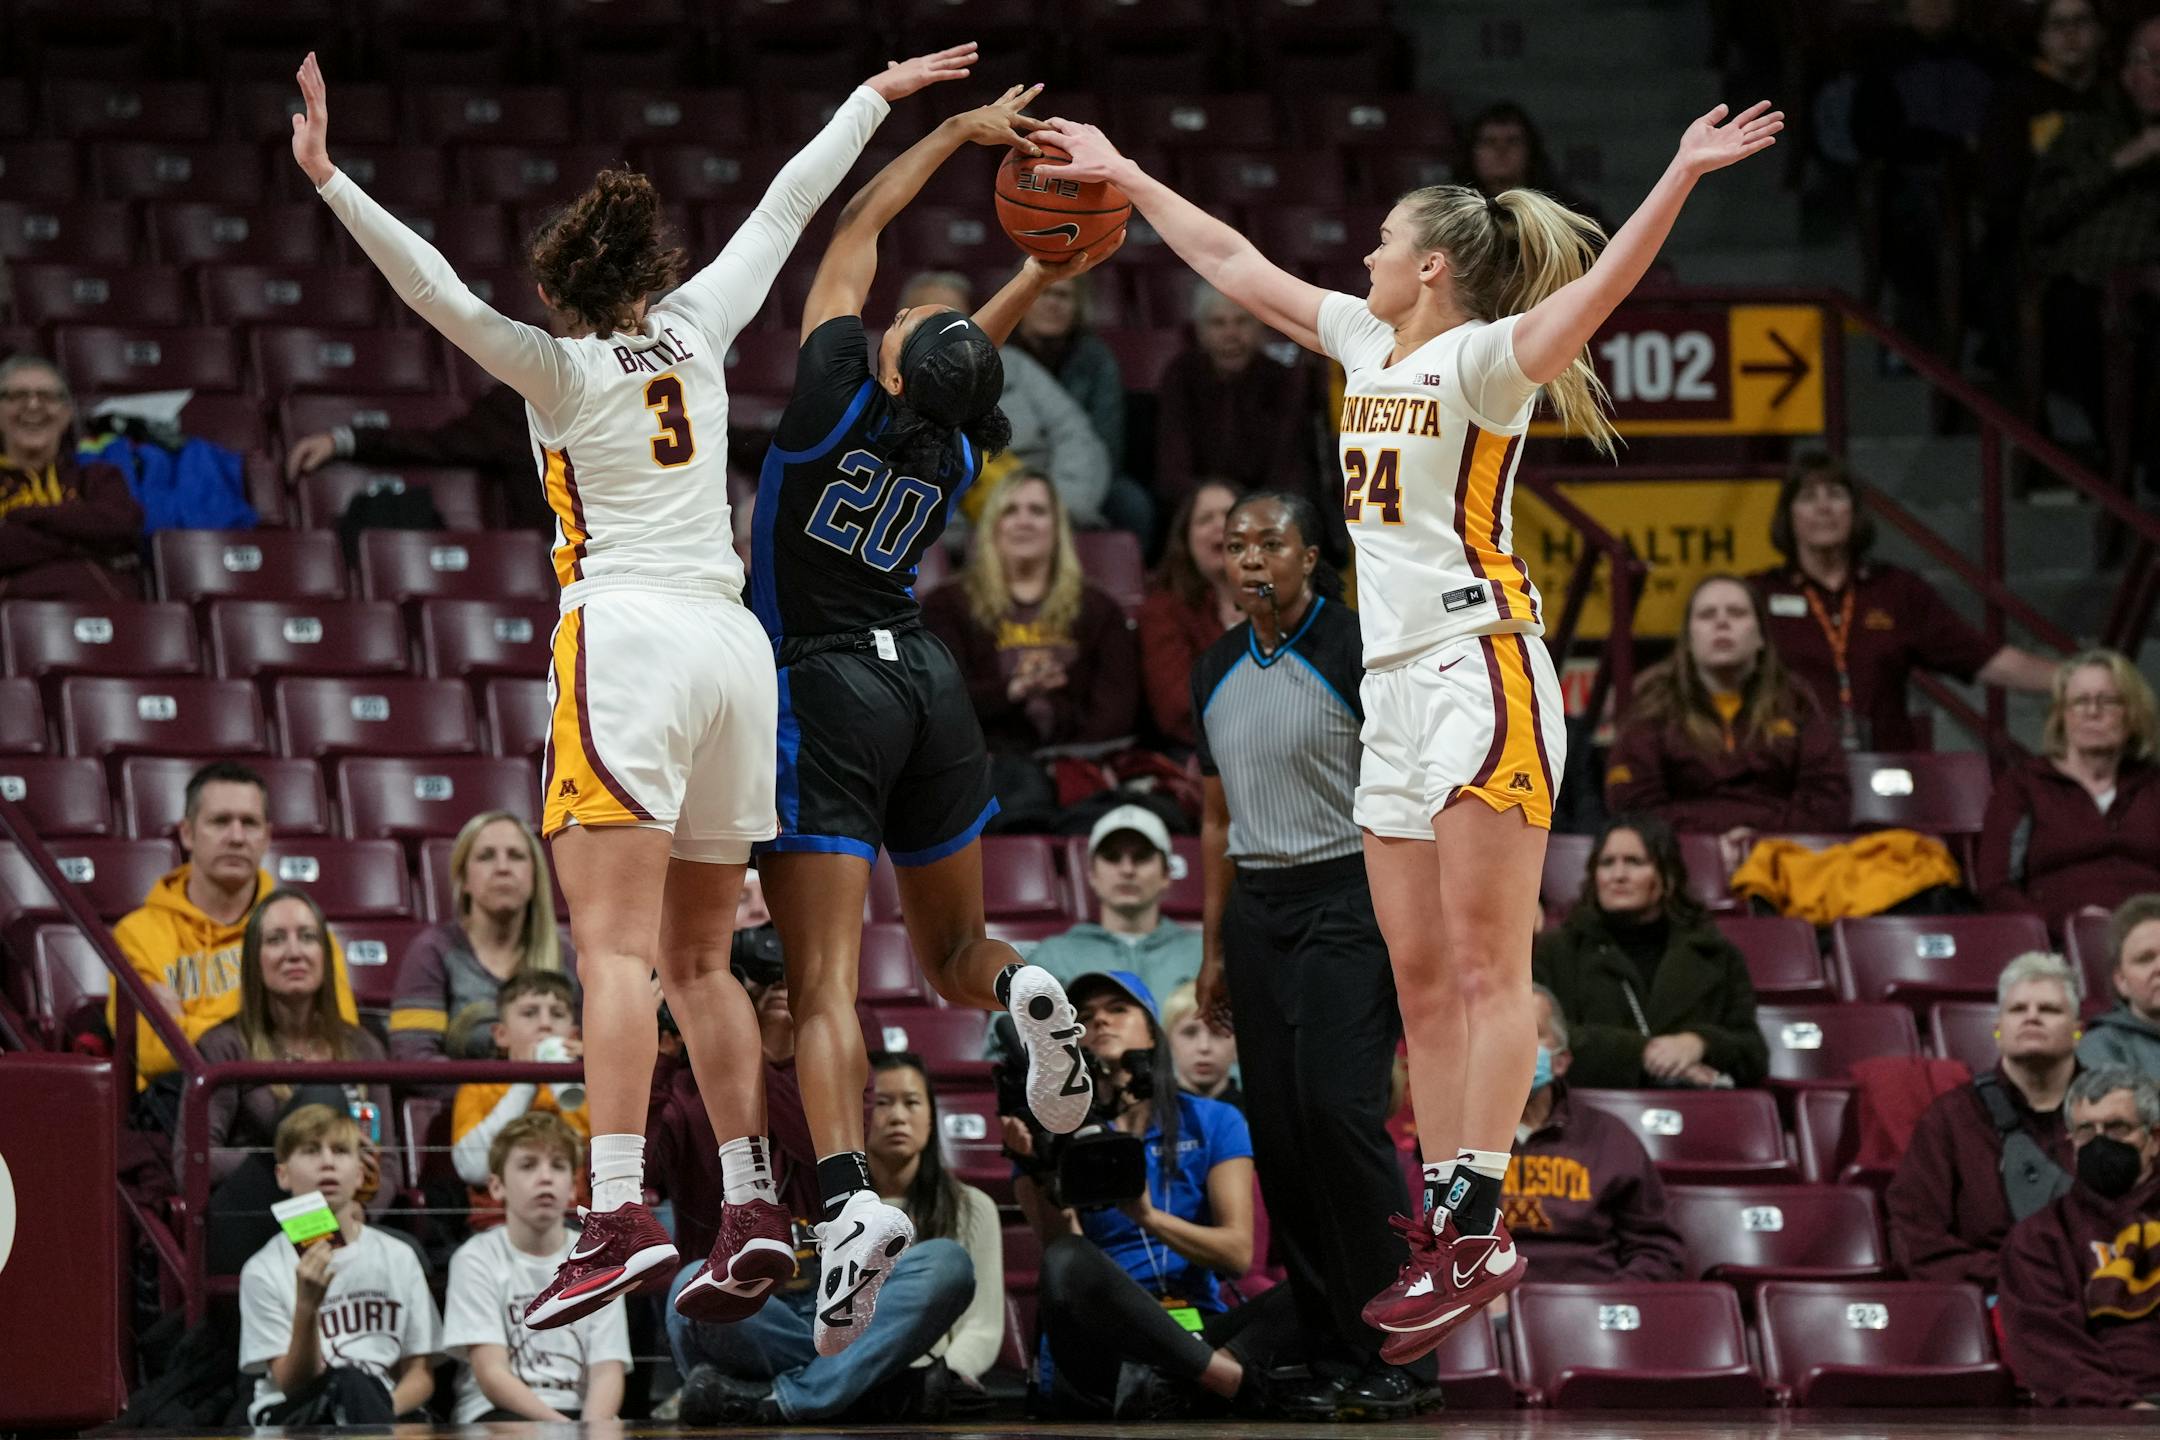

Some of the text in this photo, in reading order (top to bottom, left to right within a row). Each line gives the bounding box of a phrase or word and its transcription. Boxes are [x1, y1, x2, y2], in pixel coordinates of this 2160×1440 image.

[1601, 330, 1716, 402] 102
[642, 371, 697, 469] 3
[794, 448, 943, 573] 20
[1343, 447, 1406, 526] 24
